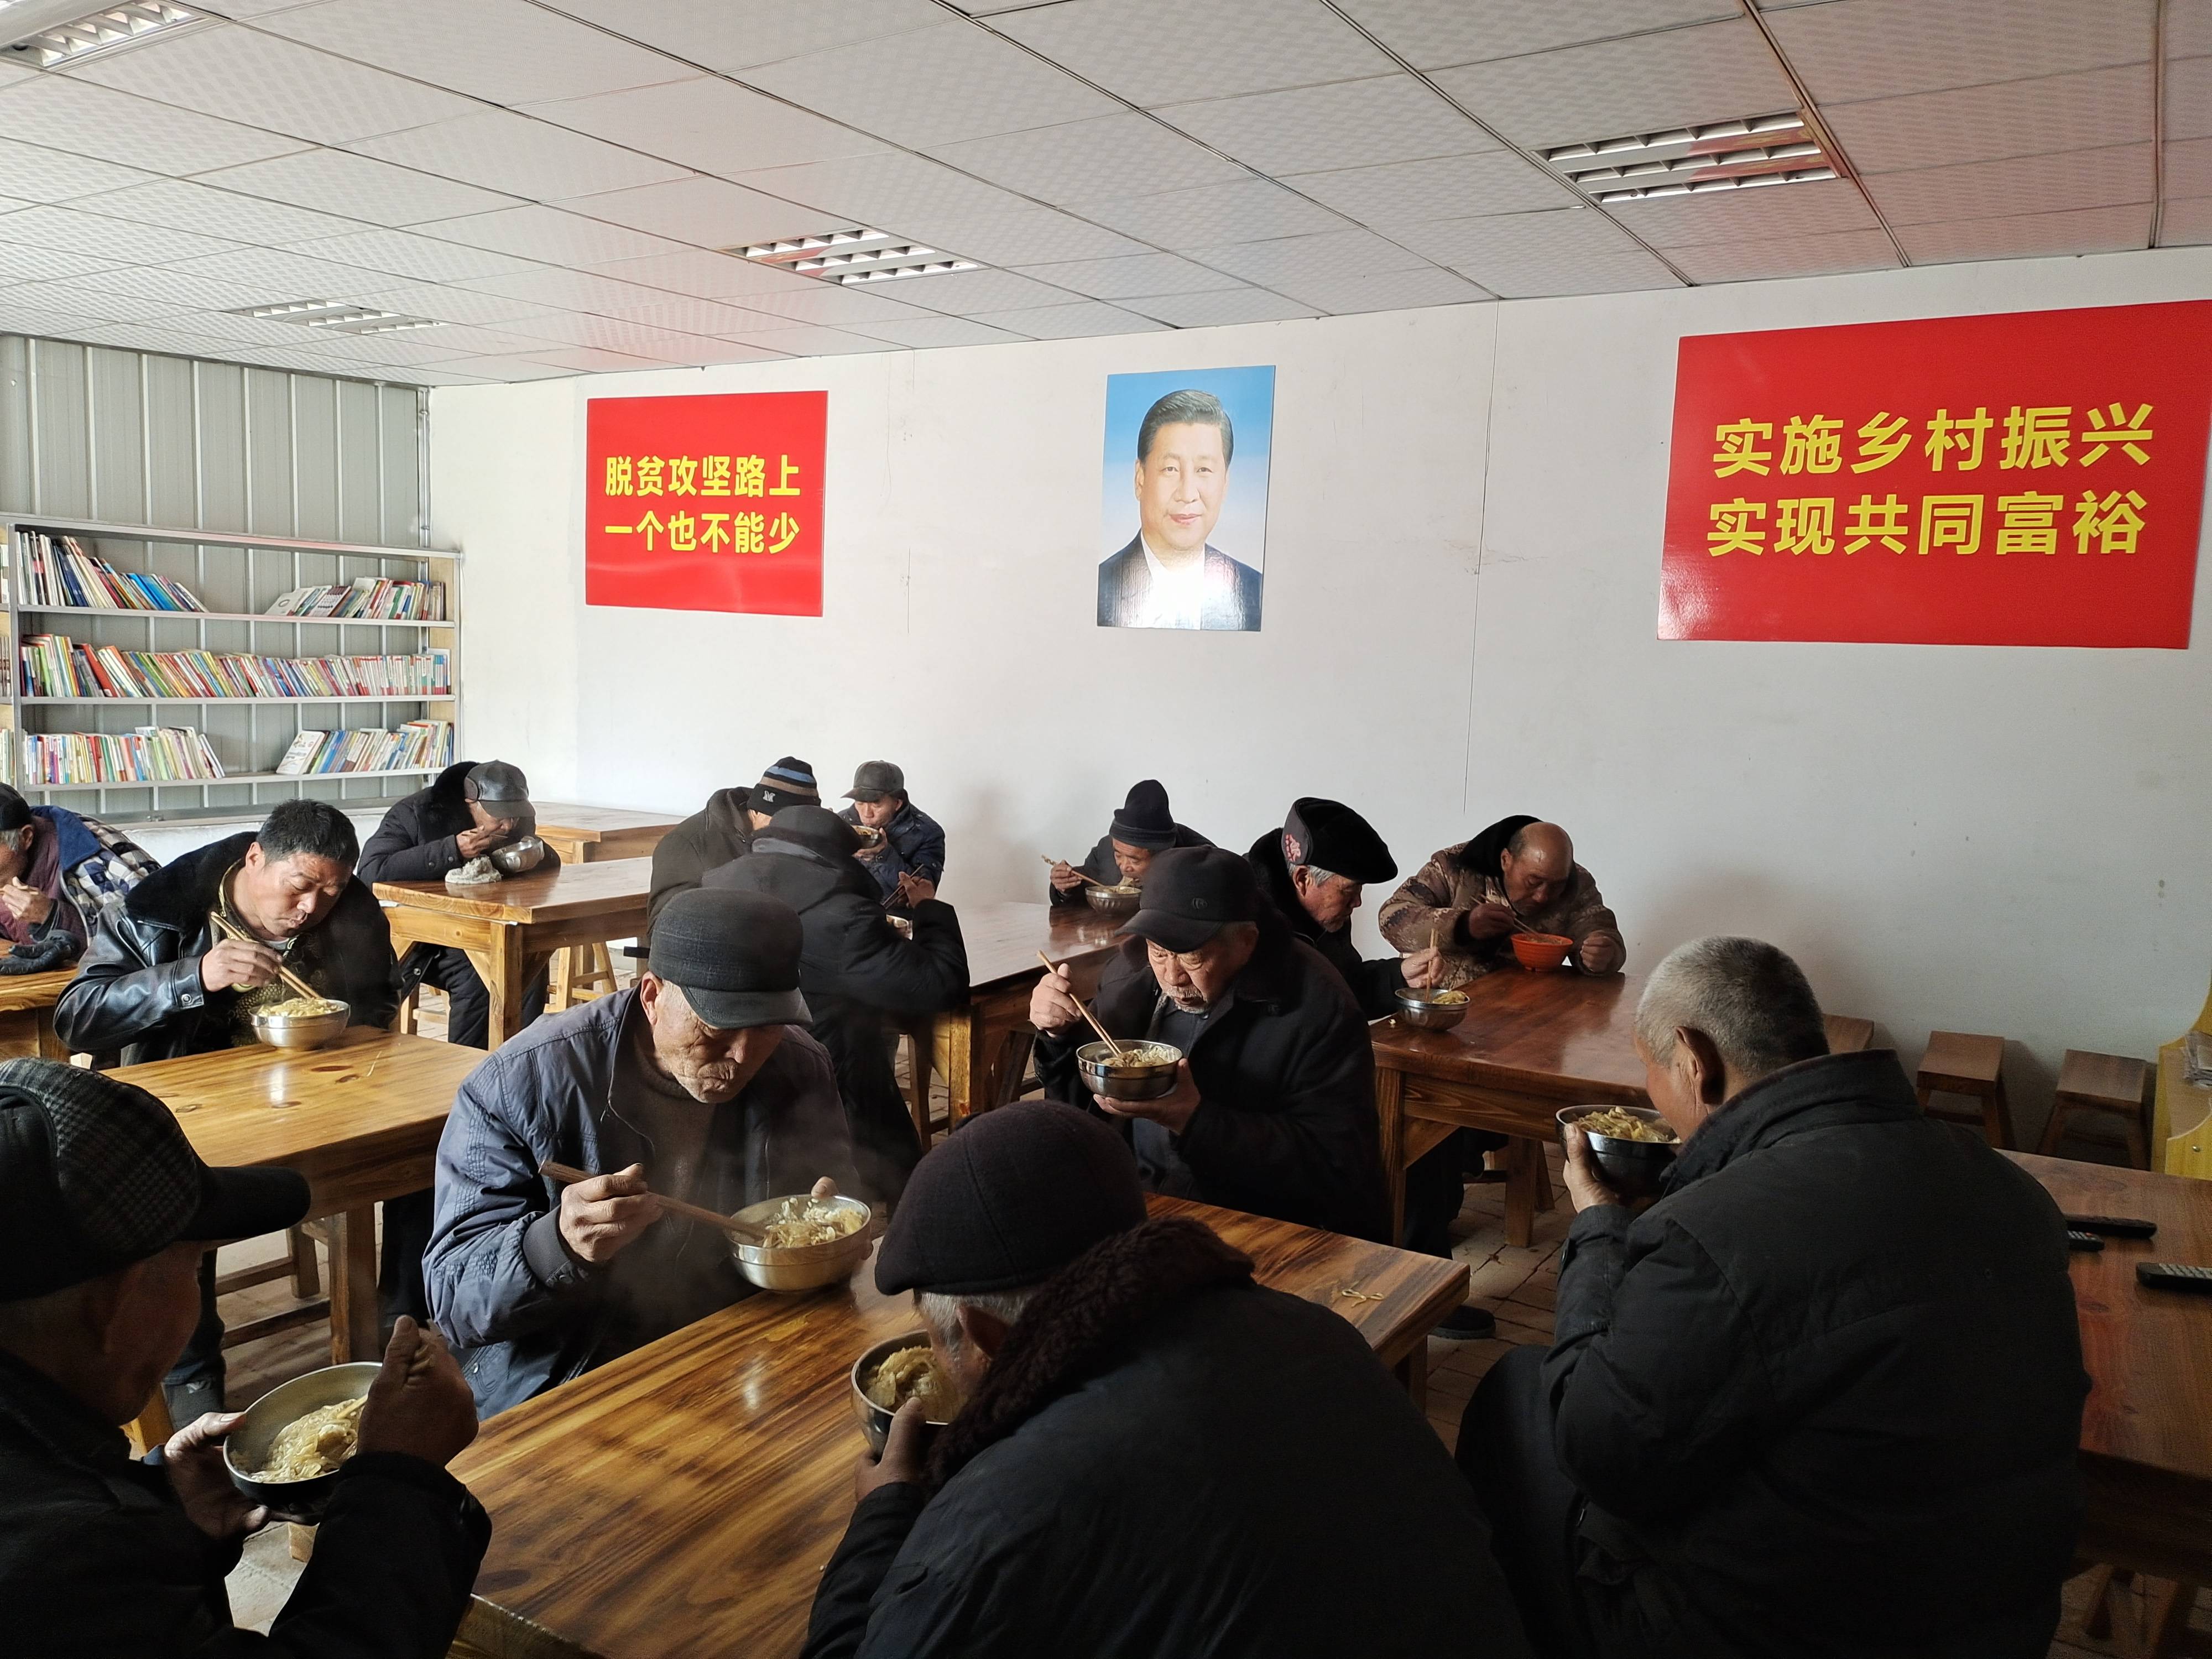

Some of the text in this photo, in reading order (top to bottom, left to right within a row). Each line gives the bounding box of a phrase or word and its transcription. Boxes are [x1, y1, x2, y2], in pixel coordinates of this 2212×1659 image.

[1712, 402, 2153, 478] 实施乡村振兴
[604, 454, 801, 498] 脱贫攻坚路上
[604, 510, 800, 554] 一个也不能少
[1707, 489, 2147, 557] 实现共同富裕
